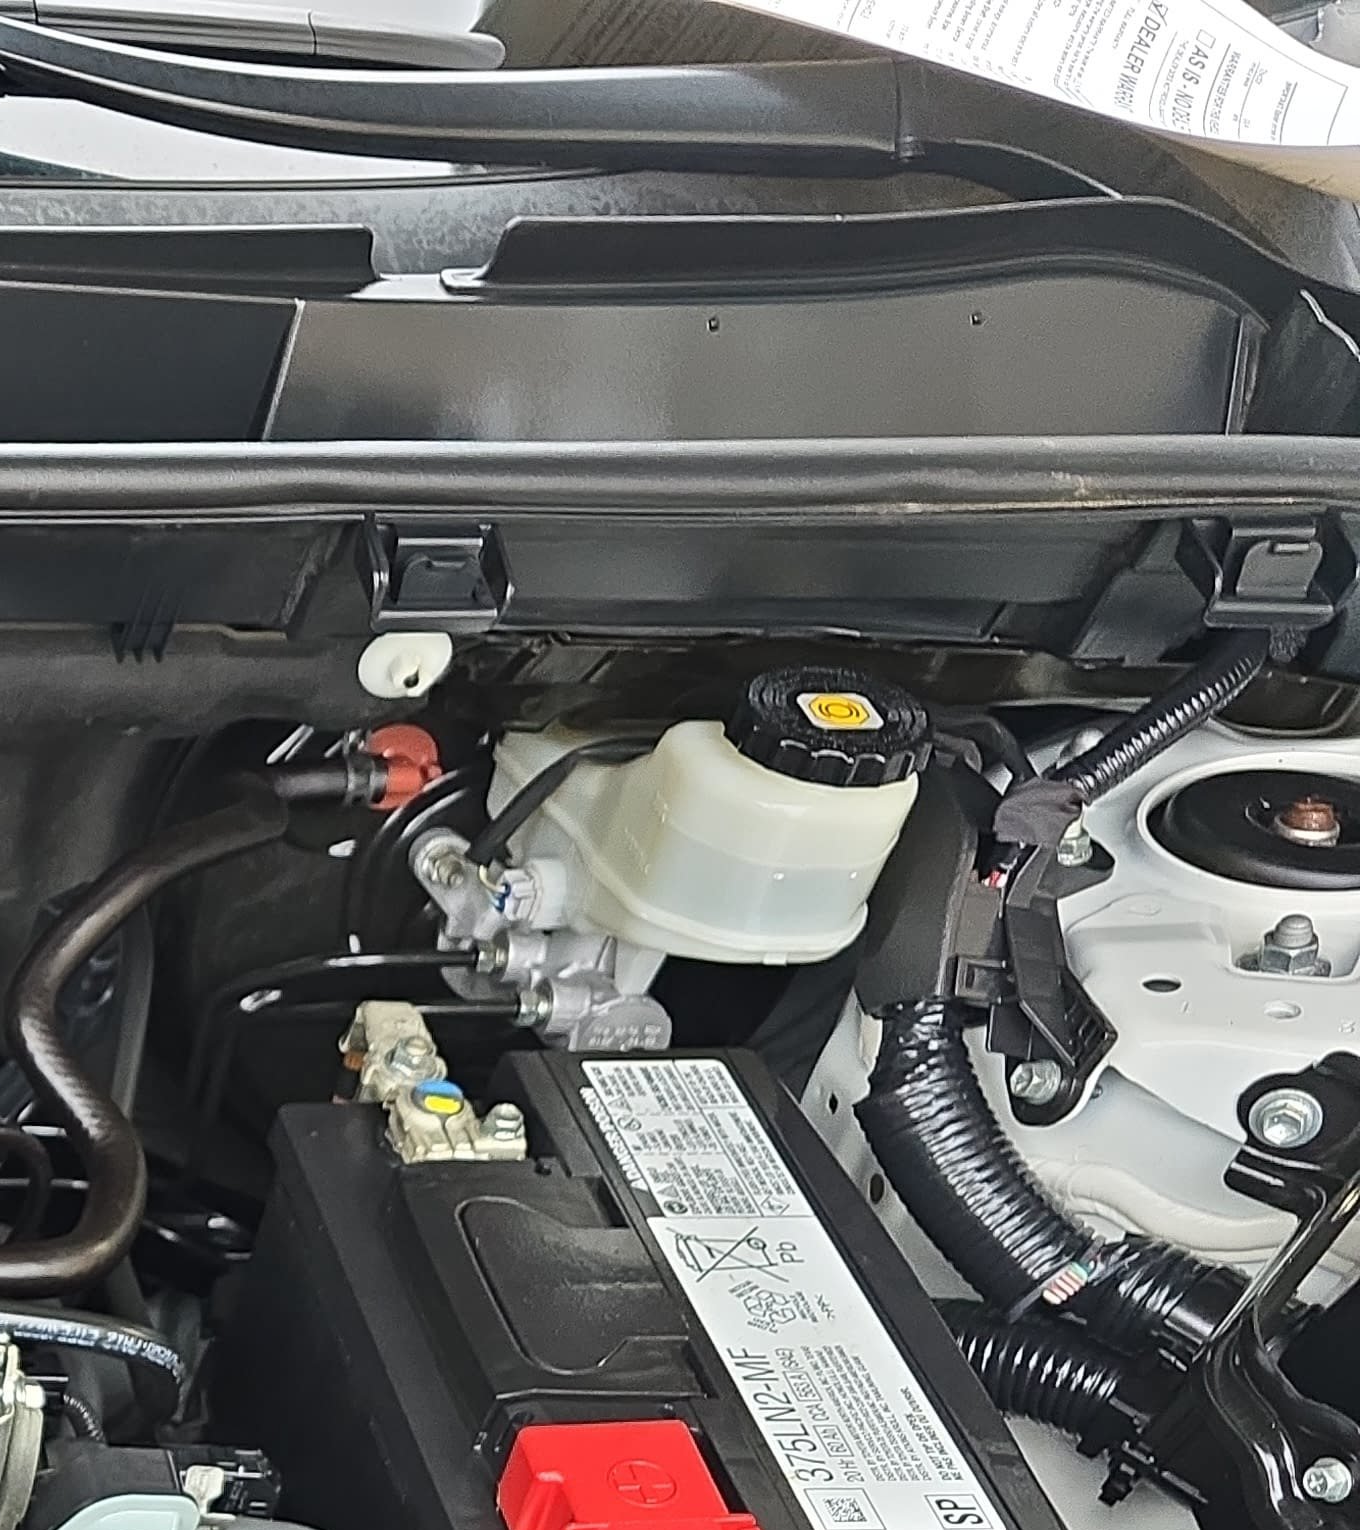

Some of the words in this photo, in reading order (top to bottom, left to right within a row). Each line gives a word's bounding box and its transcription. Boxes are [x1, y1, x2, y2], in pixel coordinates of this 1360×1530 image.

[1124, 16, 1161, 74] DEALER
[1188, 45, 1208, 70] AS
[1182, 68, 1201, 85] IS
[1174, 89, 1193, 109] NO
[775, 1241, 805, 1263] Pb
[728, 1347, 833, 1481] 375LN2-MF
[805, 1403, 830, 1421] CCA
[922, 1443, 936, 1455] TIP
[928, 1455, 945, 1469] NOT
[843, 1470, 865, 1482] 20
[938, 1470, 952, 1481] DO
[935, 1498, 984, 1525] SP
